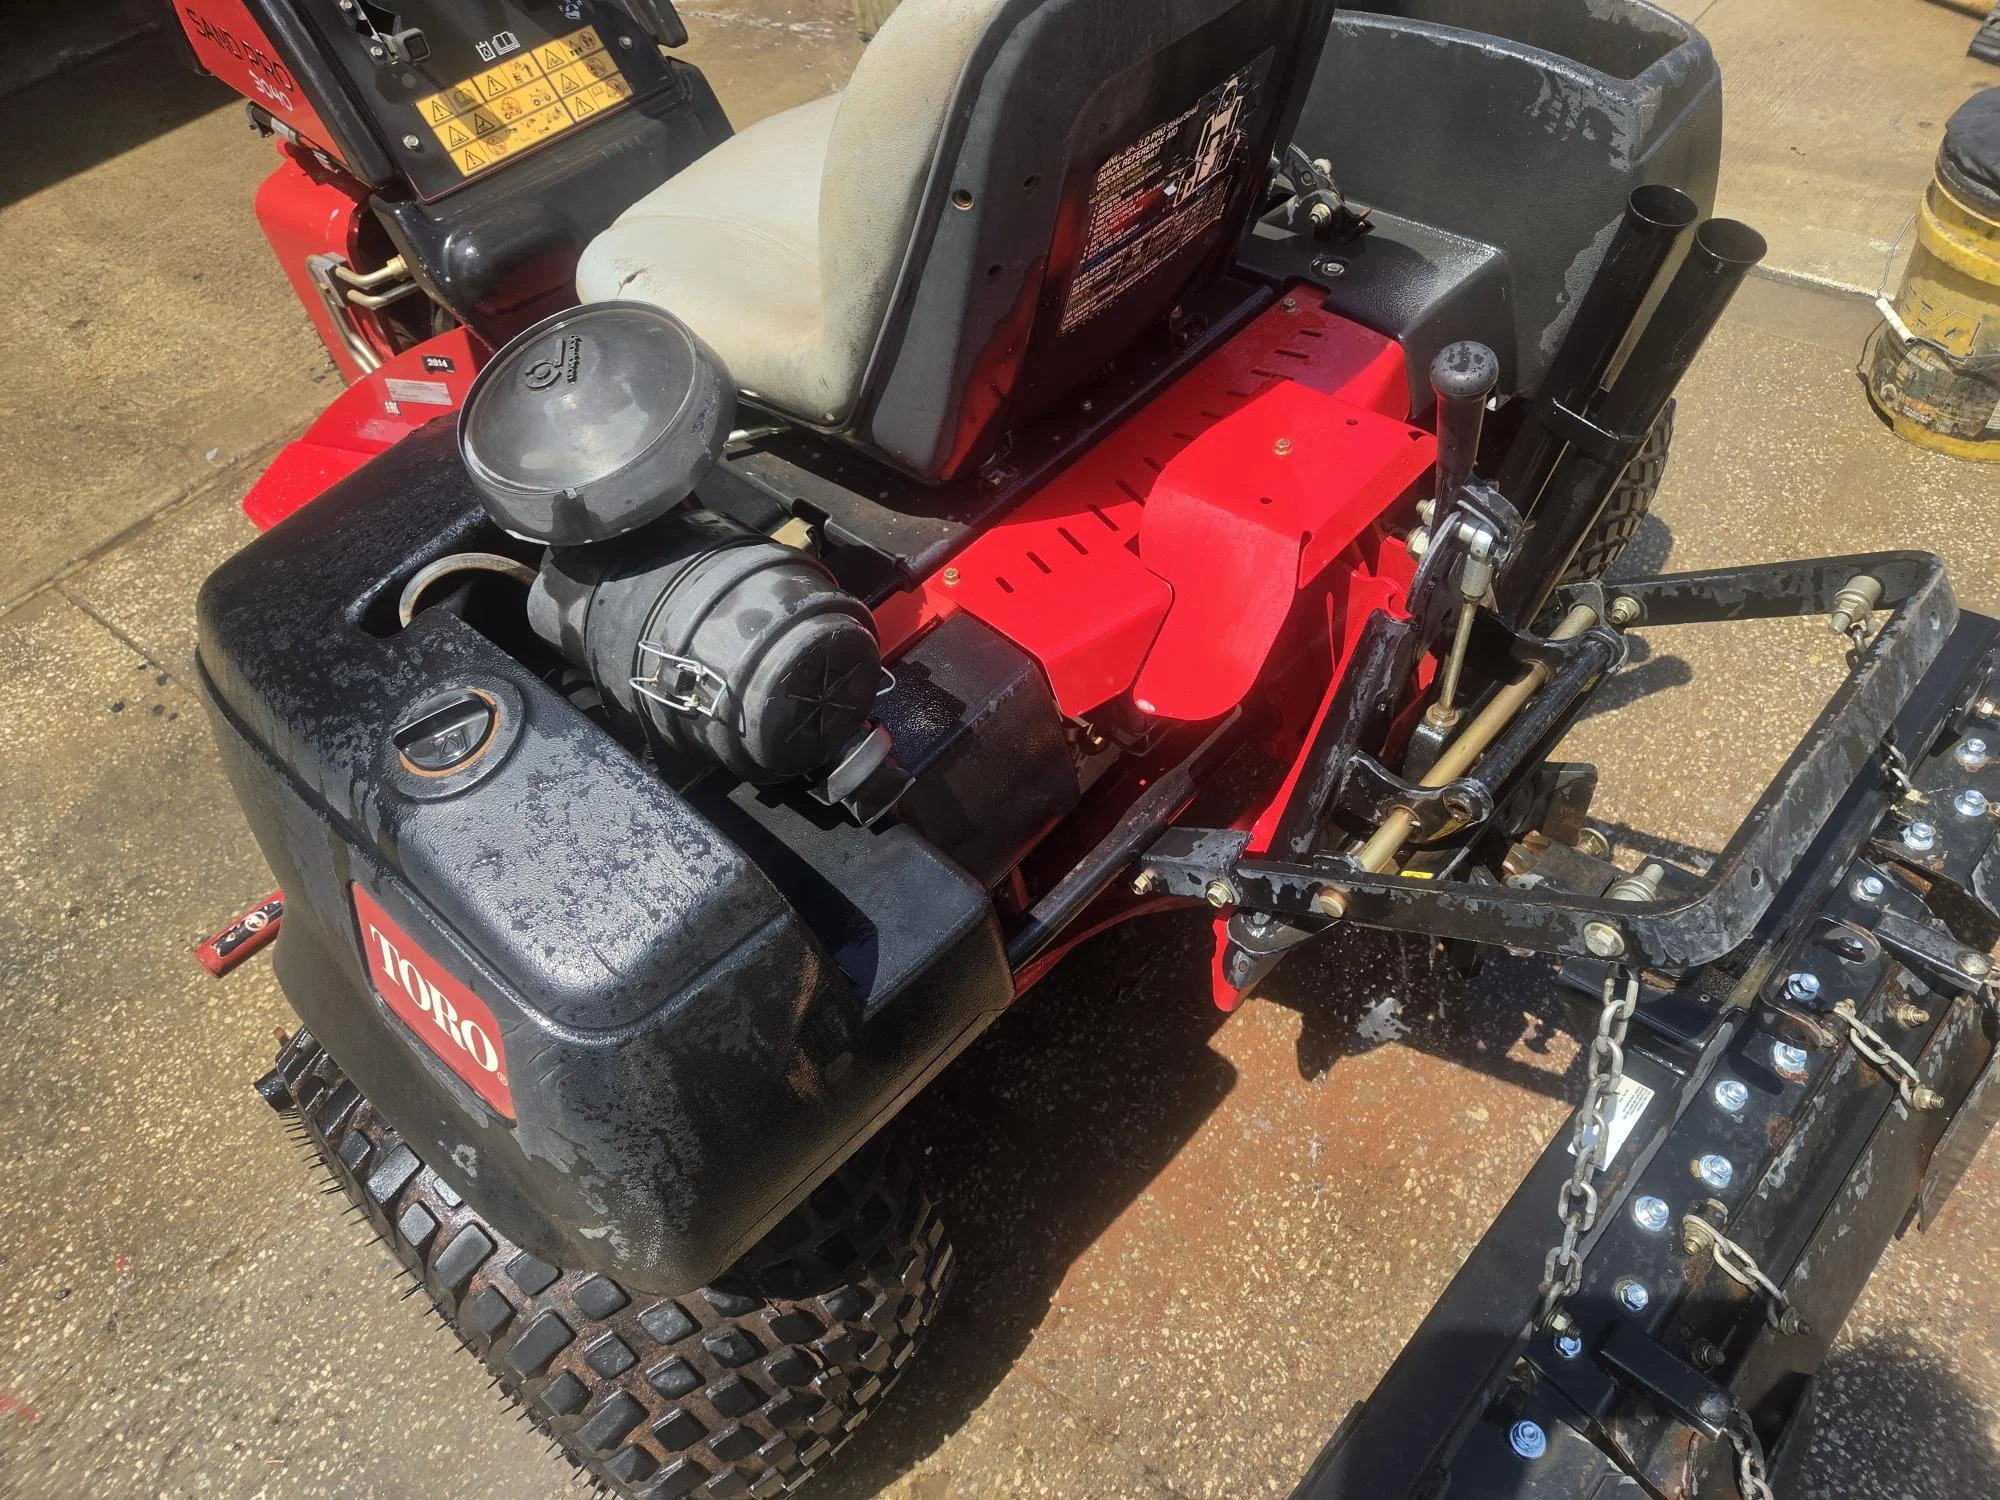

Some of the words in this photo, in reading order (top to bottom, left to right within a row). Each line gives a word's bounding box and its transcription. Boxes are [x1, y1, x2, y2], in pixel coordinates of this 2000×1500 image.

[185, 7, 243, 60] SAND
[242, 41, 293, 92] PRO
[249, 69, 293, 111] 3040
[1098, 161, 1120, 183] QUICK
[1122, 134, 1165, 168] REFERENCE
[1166, 126, 1178, 141] AID
[1150, 125, 1166, 142] PRO
[426, 358, 448, 368] 2014
[369, 923, 499, 1073] TORO
